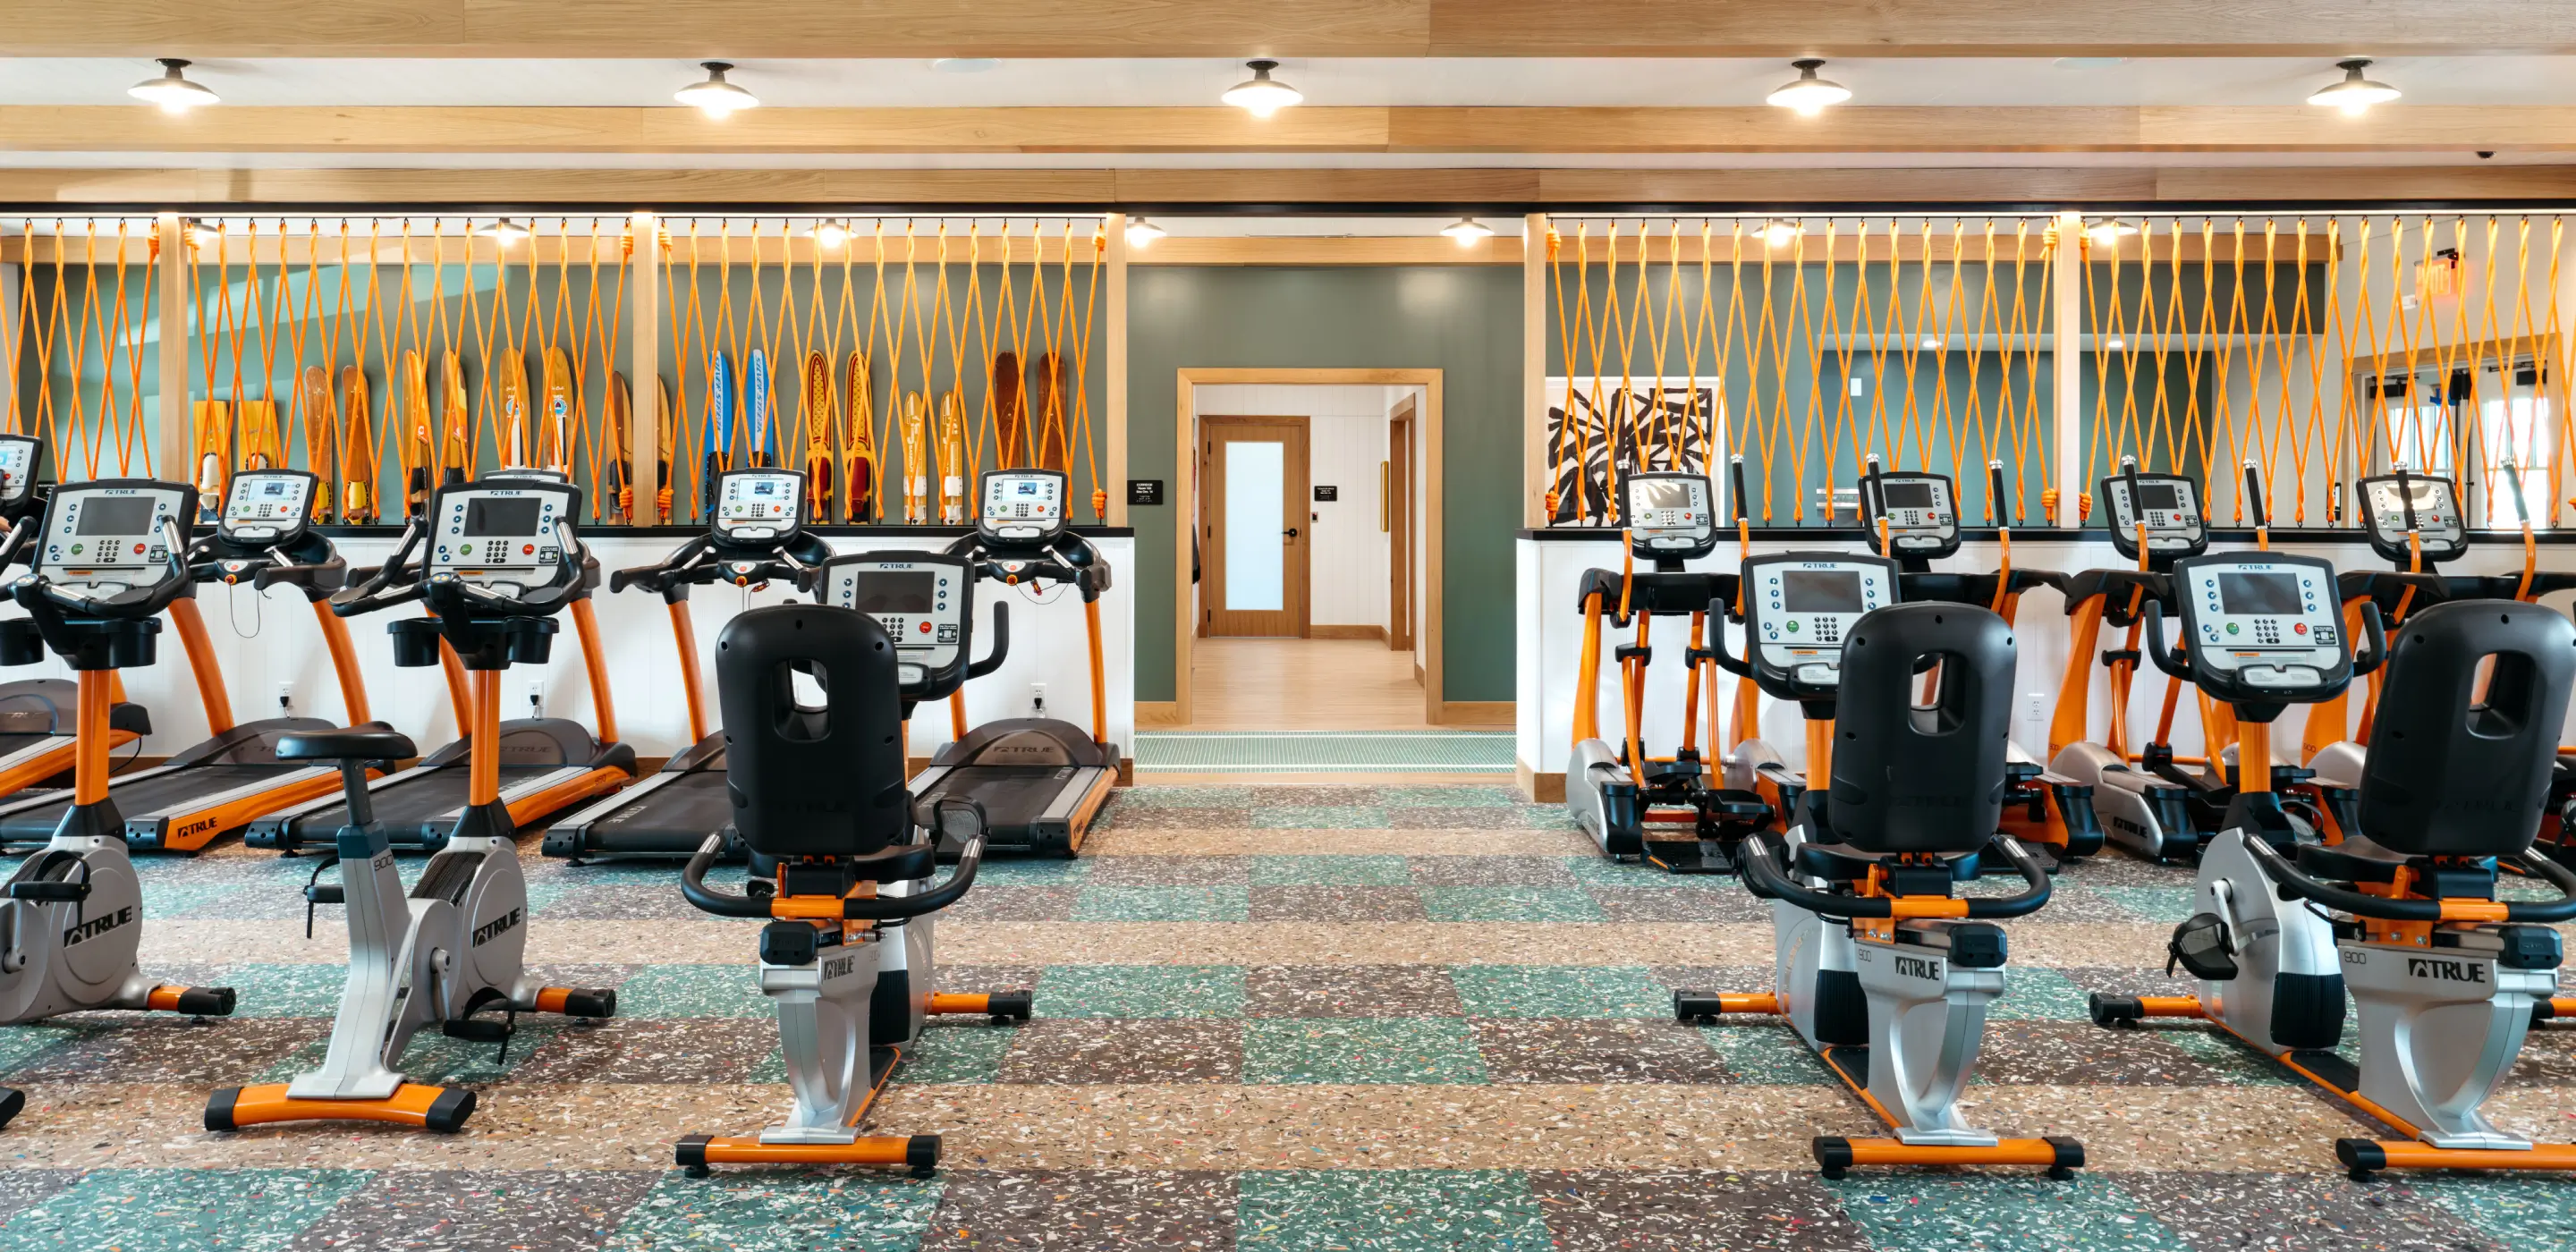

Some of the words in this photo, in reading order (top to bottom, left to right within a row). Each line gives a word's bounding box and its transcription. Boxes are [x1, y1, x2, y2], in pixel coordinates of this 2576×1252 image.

[189, 816, 217, 835] TRUE
[374, 854, 394, 872] 900
[81, 905, 133, 939] TRUE
[484, 907, 521, 939] TRUE
[832, 954, 855, 978] TRUE
[1859, 948, 1872, 962] 900
[2343, 951, 2367, 965] 900
[1906, 958, 1939, 981] TRUE
[2428, 960, 2486, 984] TRUE
